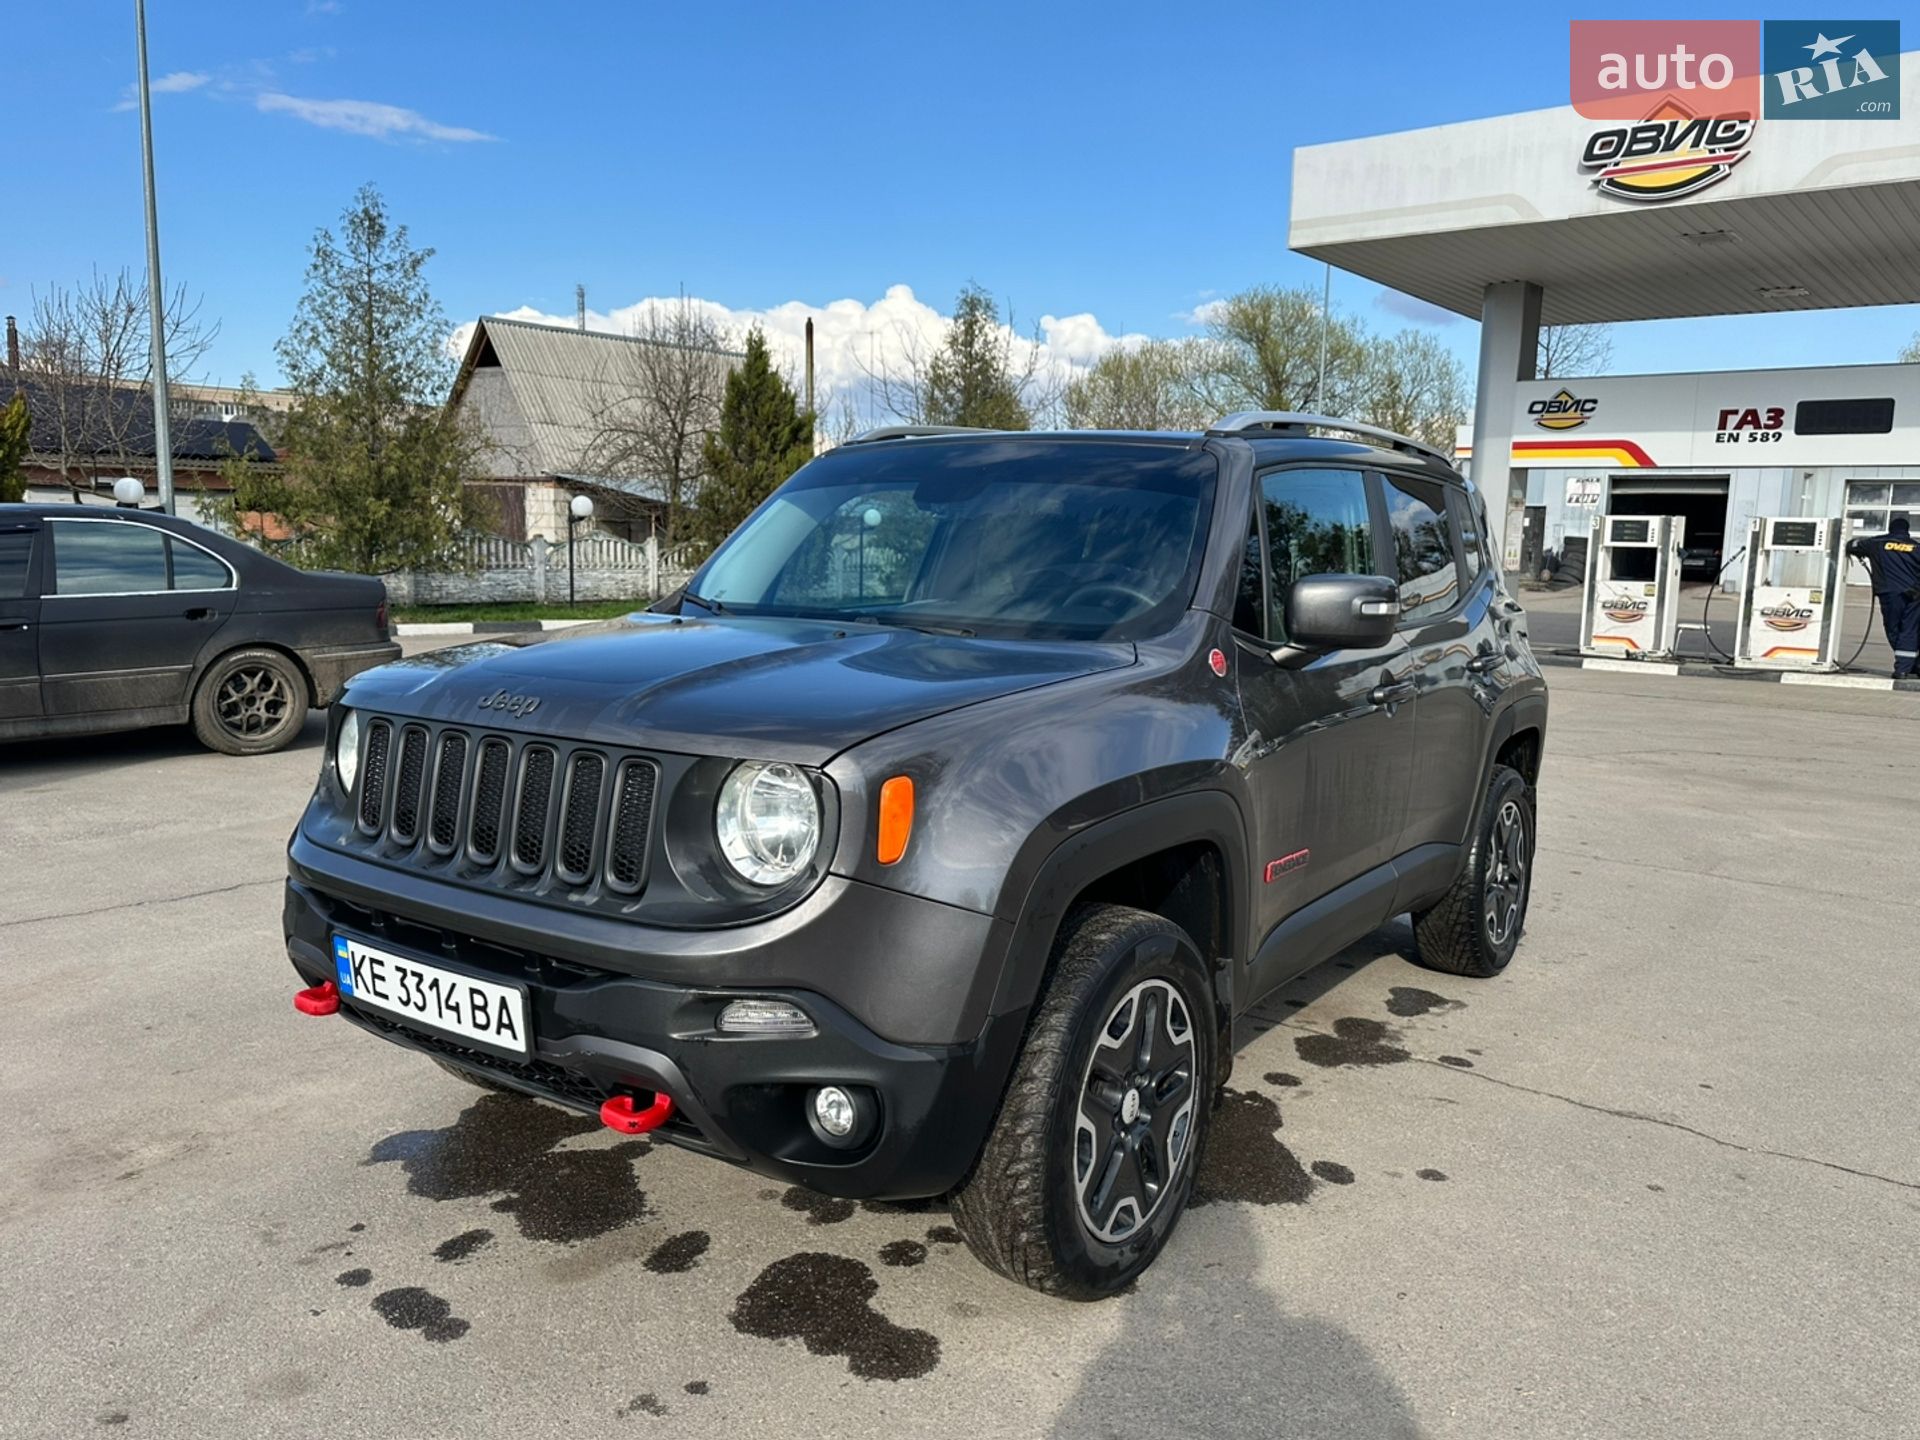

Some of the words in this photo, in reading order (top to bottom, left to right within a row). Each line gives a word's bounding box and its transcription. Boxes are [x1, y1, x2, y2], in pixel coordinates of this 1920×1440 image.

[1582, 111, 1752, 163] ОВИС
[1527, 398, 1599, 415] ОВИС
[1717, 407, 1786, 431] ГАЗ
[1715, 432, 1740, 443] EN
[1747, 431, 1783, 443] 589
[1761, 606, 1813, 619] ОВИС
[477, 687, 542, 719] Jeep
[340, 972, 351, 986] UA
[351, 951, 389, 1001] KE
[395, 965, 462, 1025] 3314
[468, 987, 518, 1041] BA
